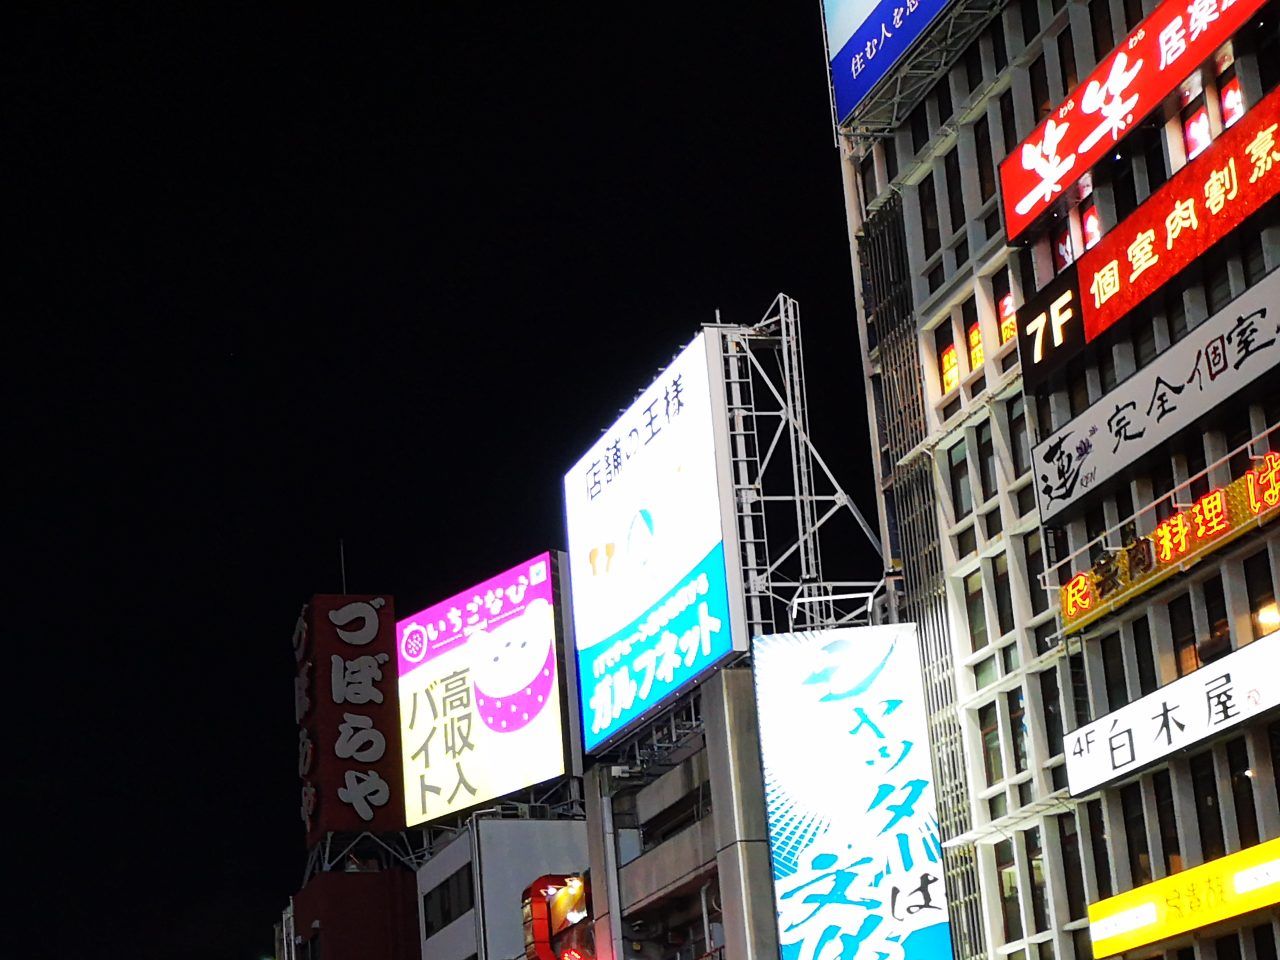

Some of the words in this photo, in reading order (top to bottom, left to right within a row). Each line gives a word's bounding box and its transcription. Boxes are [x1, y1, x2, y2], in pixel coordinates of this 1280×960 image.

[1015, 52, 1144, 216] 笑笑
[1089, 123, 1280, 309] 個室肉割烹
[1026, 290, 1073, 364] 7F
[585, 374, 686, 500] 店舗の王様
[328, 597, 390, 822] づぼらや
[590, 602, 721, 733] ガルフネット
[1073, 730, 1097, 759] 4F
[1109, 673, 1242, 772] 白木屋
[409, 680, 441, 815] バイト
[439, 667, 478, 805] 高収入
